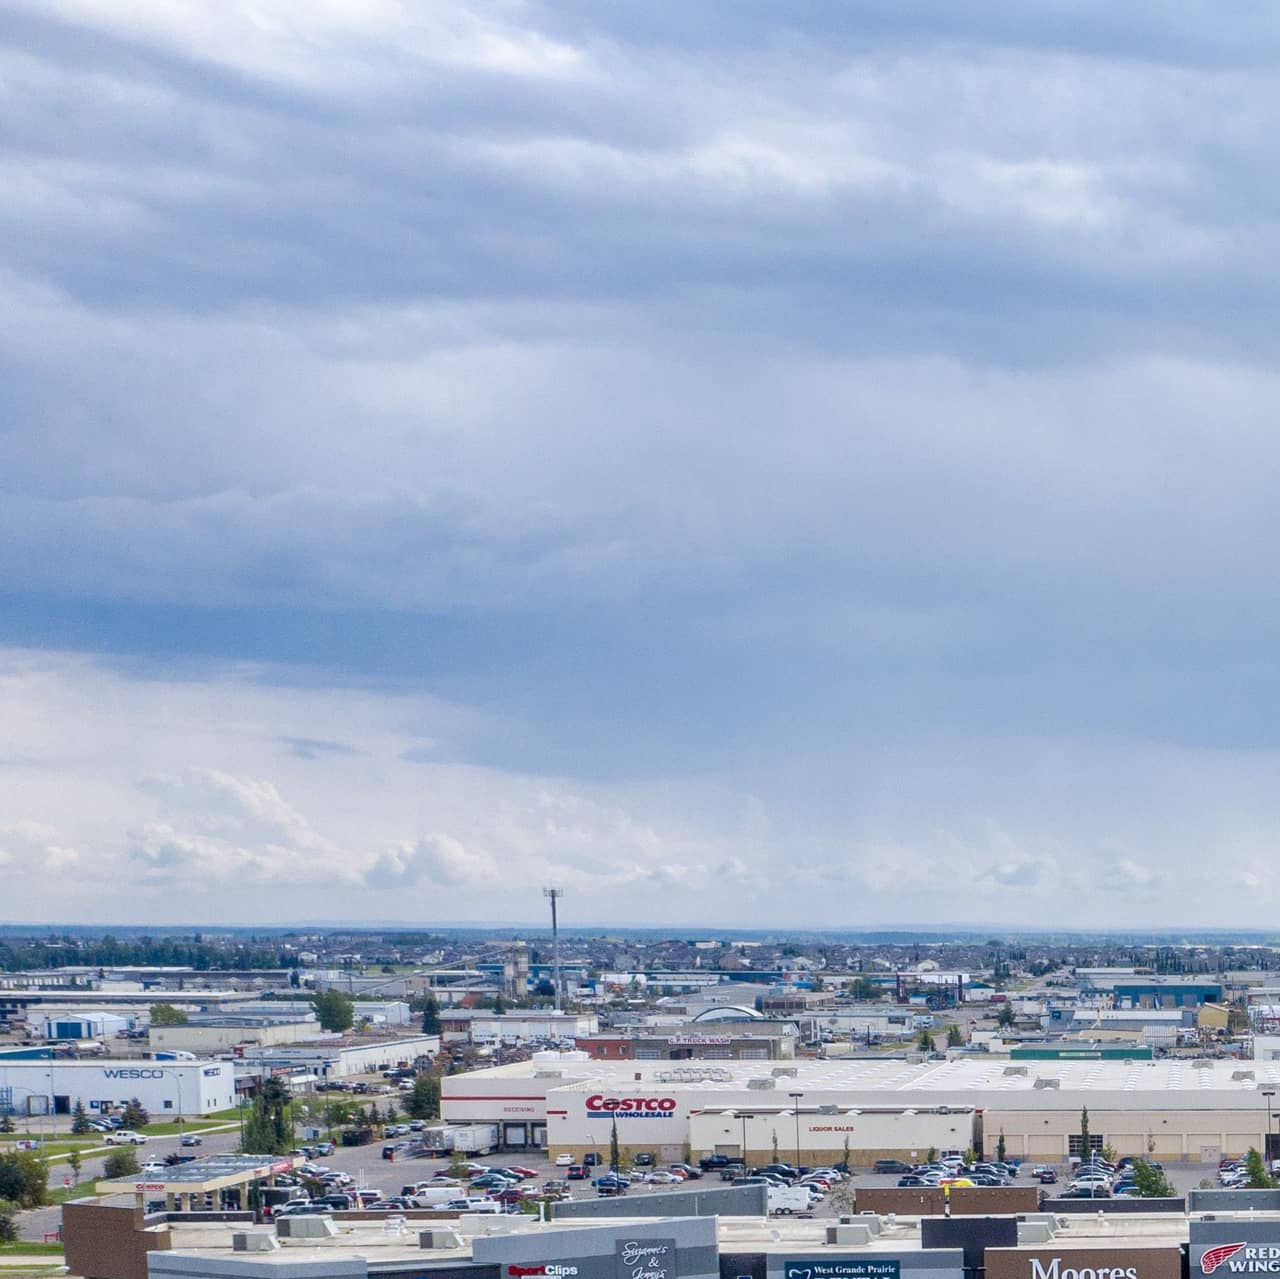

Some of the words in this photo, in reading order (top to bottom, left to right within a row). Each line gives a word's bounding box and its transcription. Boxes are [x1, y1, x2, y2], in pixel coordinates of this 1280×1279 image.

[104, 1069, 163, 1079] WESCO
[1245, 1247, 1280, 1259] RED
[648, 1256, 660, 1267] &
[1228, 1260, 1280, 1272] WING
[814, 1265, 834, 1274] West
[835, 1265, 865, 1274] Grande
[867, 1264, 895, 1273] Prairie
